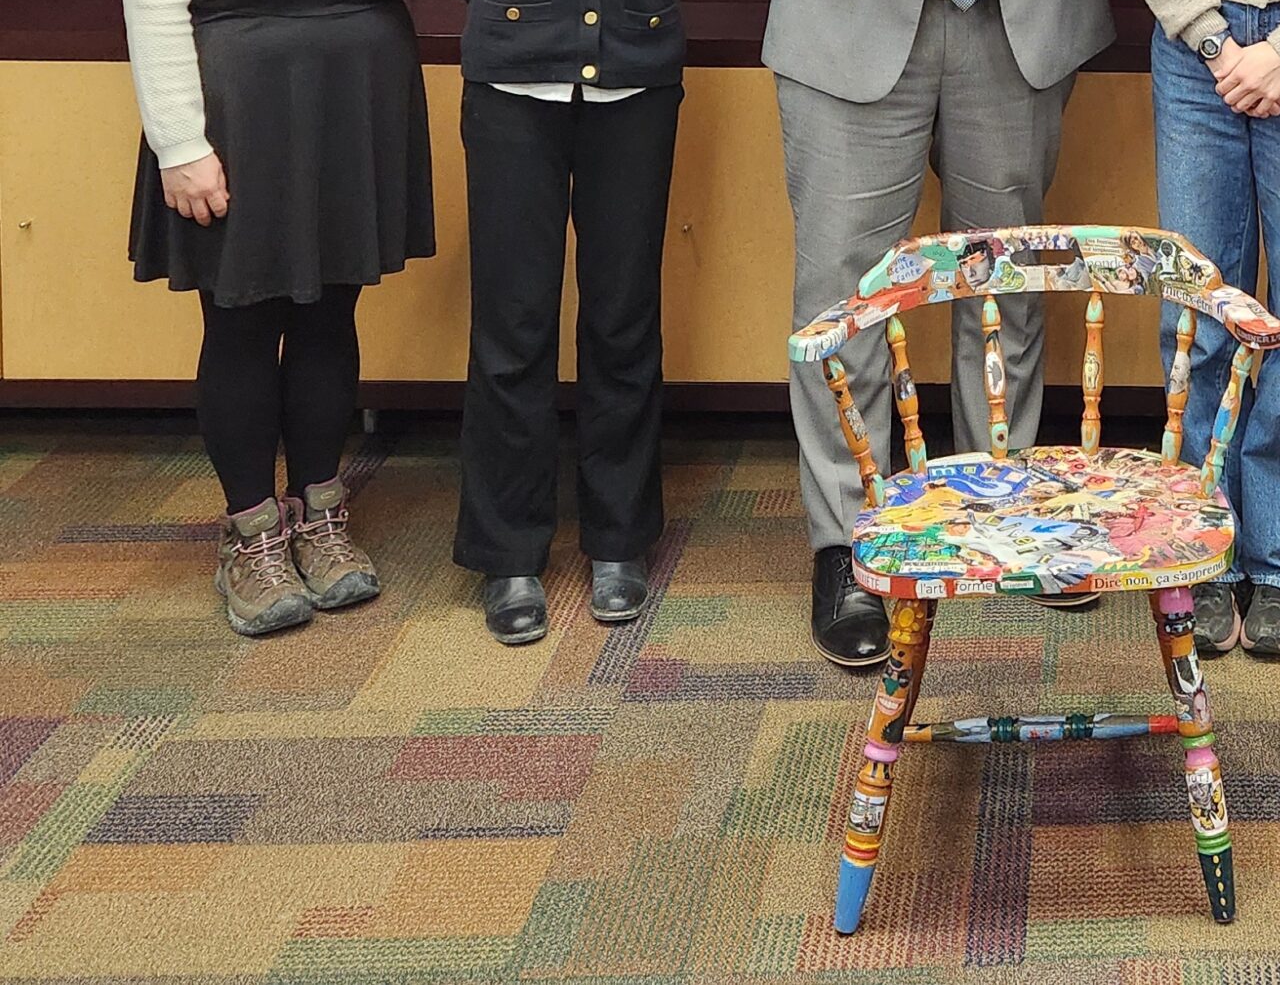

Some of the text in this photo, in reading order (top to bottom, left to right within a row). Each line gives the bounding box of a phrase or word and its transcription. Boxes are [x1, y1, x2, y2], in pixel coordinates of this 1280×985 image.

[920, 582, 944, 595] l'art
[954, 582, 994, 592] forme
[1094, 577, 1122, 589] Dire
[1125, 577, 1153, 587] non,
[1155, 575, 1170, 586] ça
